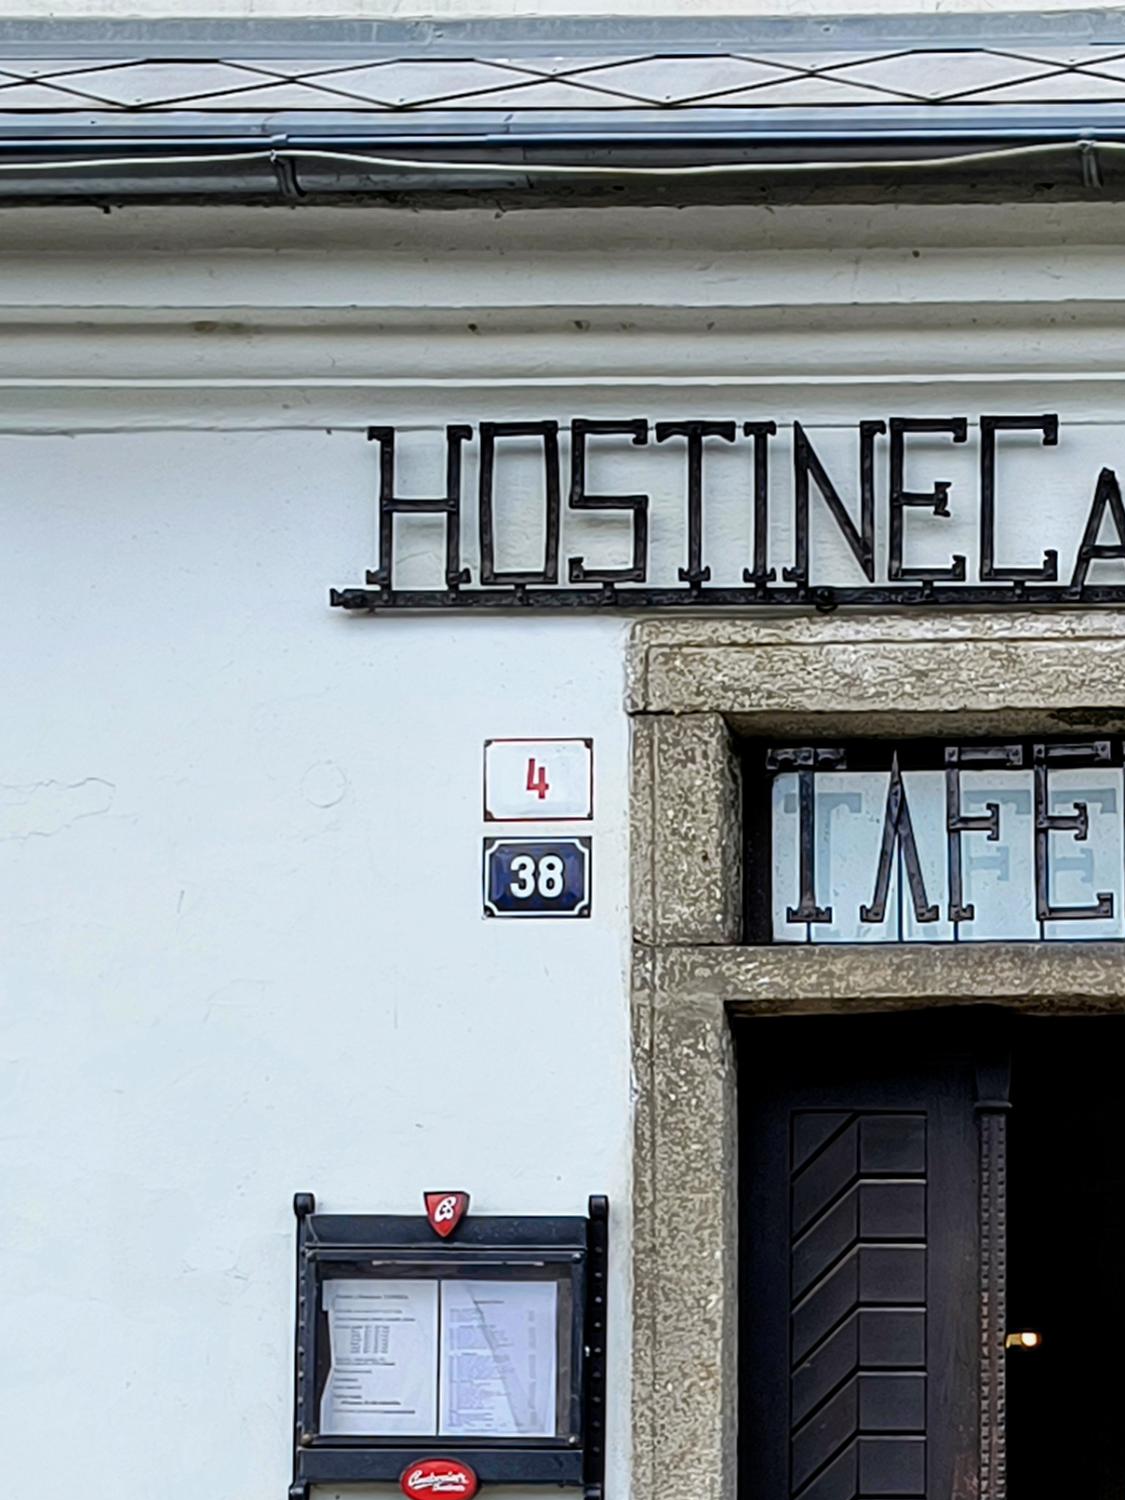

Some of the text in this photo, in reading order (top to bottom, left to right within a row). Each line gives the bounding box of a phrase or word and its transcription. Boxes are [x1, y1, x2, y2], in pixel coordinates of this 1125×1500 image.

[366, 414, 1058, 590] HOSTINEC
[526, 757, 549, 799] 4
[510, 855, 564, 898] 38
